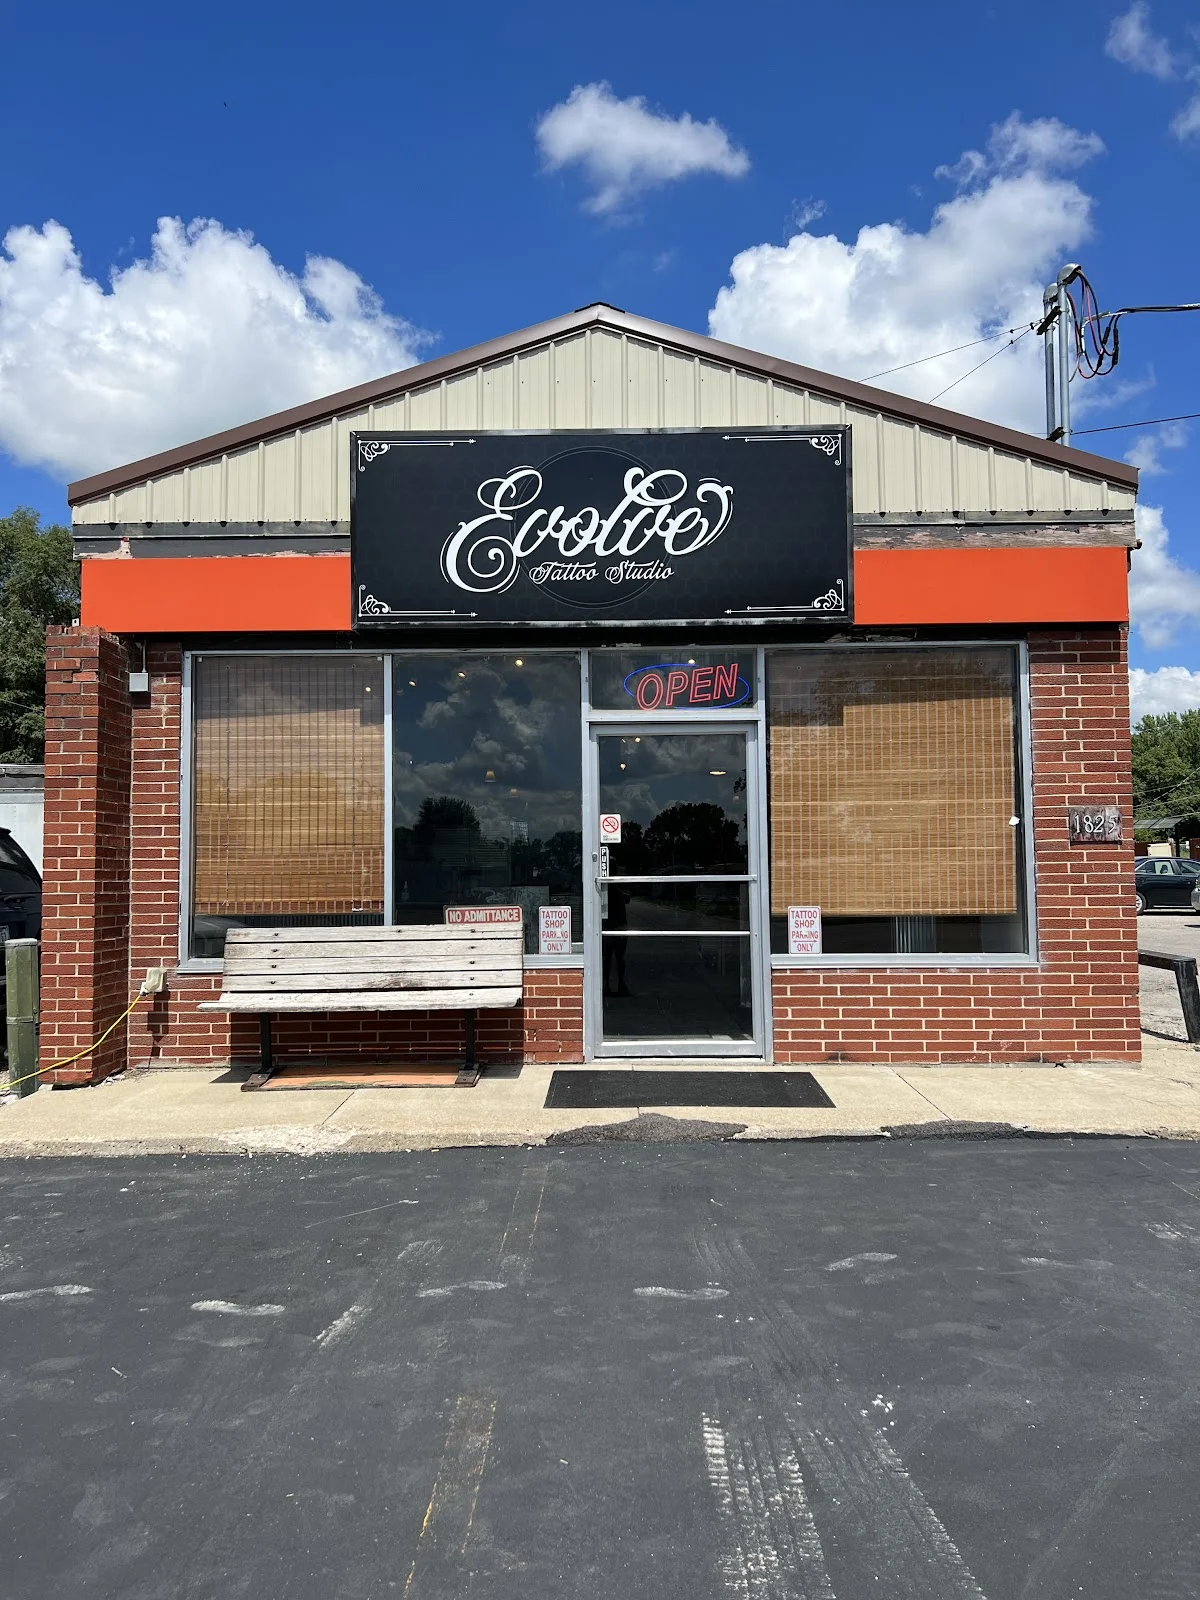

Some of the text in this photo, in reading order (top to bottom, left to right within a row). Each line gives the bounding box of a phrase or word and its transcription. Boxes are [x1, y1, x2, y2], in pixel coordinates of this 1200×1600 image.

[441, 465, 734, 593] Evolve
[529, 559, 676, 585] Tattoo Studio
[636, 663, 738, 711] OPEN
[1075, 814, 1118, 834] 1825
[449, 908, 519, 923] NO ADMITTANCE
[541, 910, 568, 919] TATTOO
[791, 910, 817, 919] TATTOO
[545, 920, 565, 928] SHOP
[794, 920, 815, 928] SHOP
[547, 943, 563, 951] ONLY
[797, 943, 814, 952] ONLY
